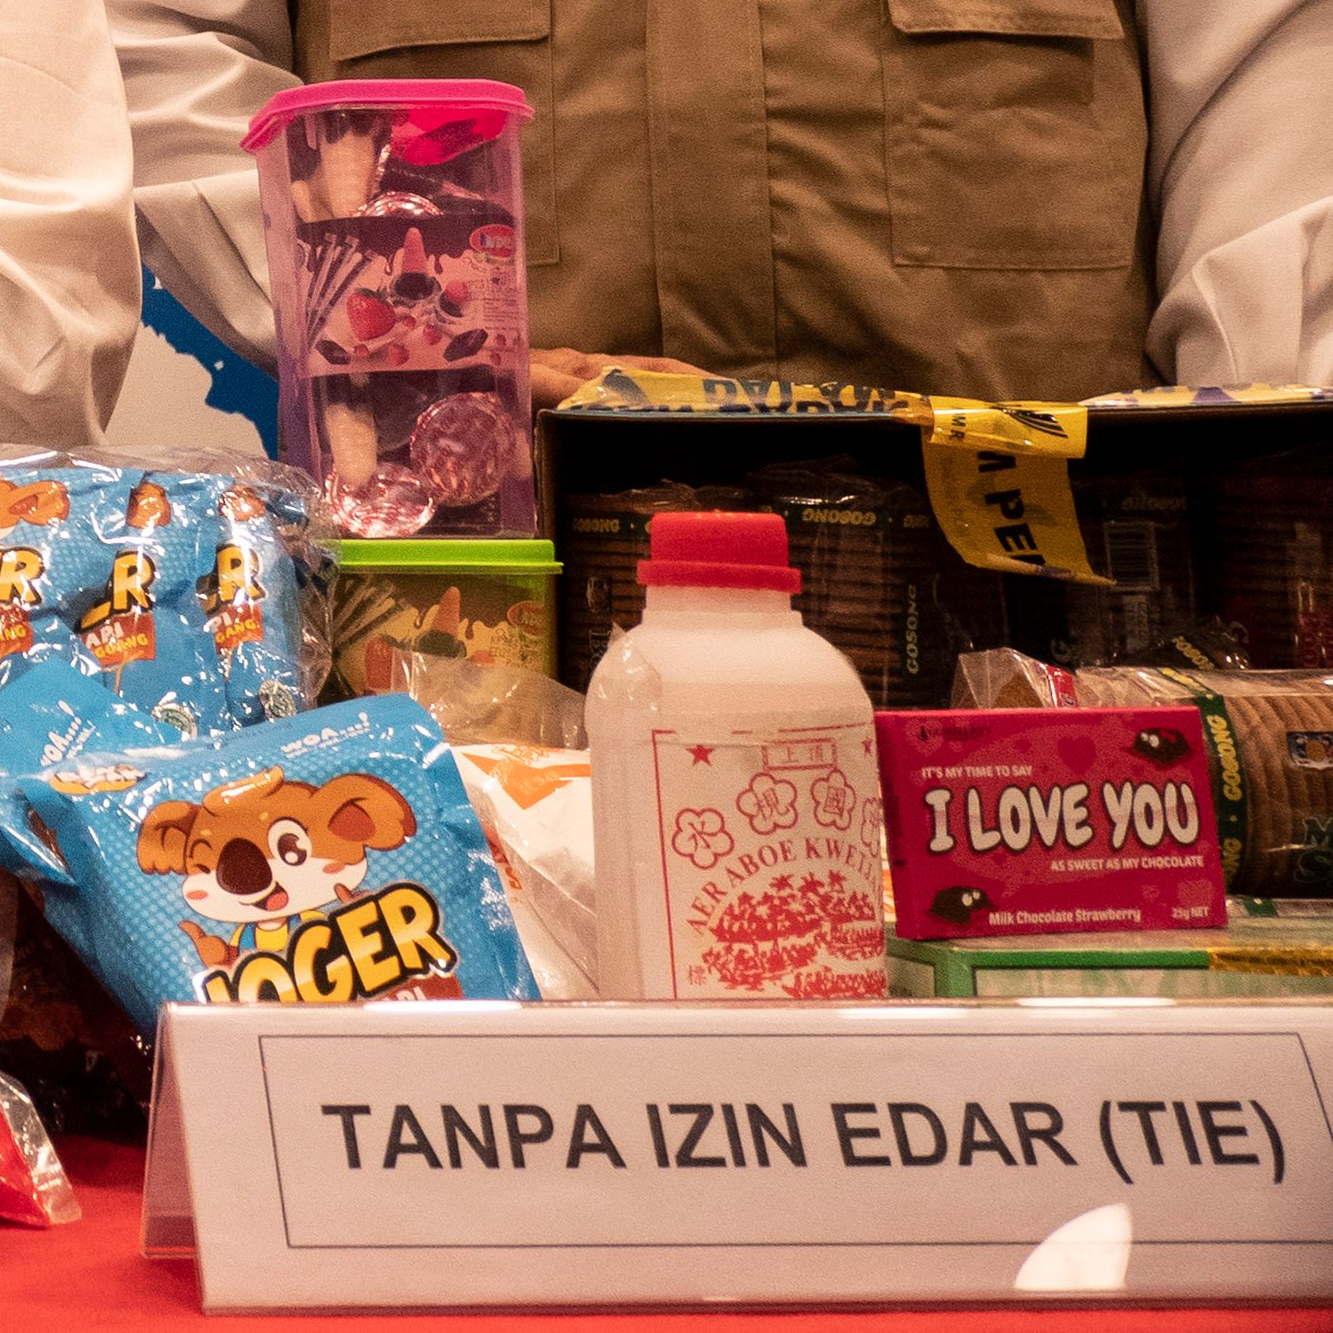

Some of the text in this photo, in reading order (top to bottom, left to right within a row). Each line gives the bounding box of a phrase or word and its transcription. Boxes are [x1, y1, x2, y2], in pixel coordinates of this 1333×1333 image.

[945, 767, 963, 778] MY
[965, 766, 993, 778] TIME
[996, 766, 1009, 777] TO
[1013, 765, 1033, 777] SAY
[1206, 714, 1243, 802] GOSONG
[924, 780, 1200, 853] I LOVE YOU
[1050, 855, 1204, 871] AS SWEET AS MY CHOCOLATE
[686, 880, 728, 936] AER
[725, 840, 797, 886] ABOE
[988, 908, 1141, 925] Milk Chocolate Strawberry
[1190, 906, 1209, 918] NET
[320, 1100, 1287, 1184] TANPA IZIN EDAR (TIE)
